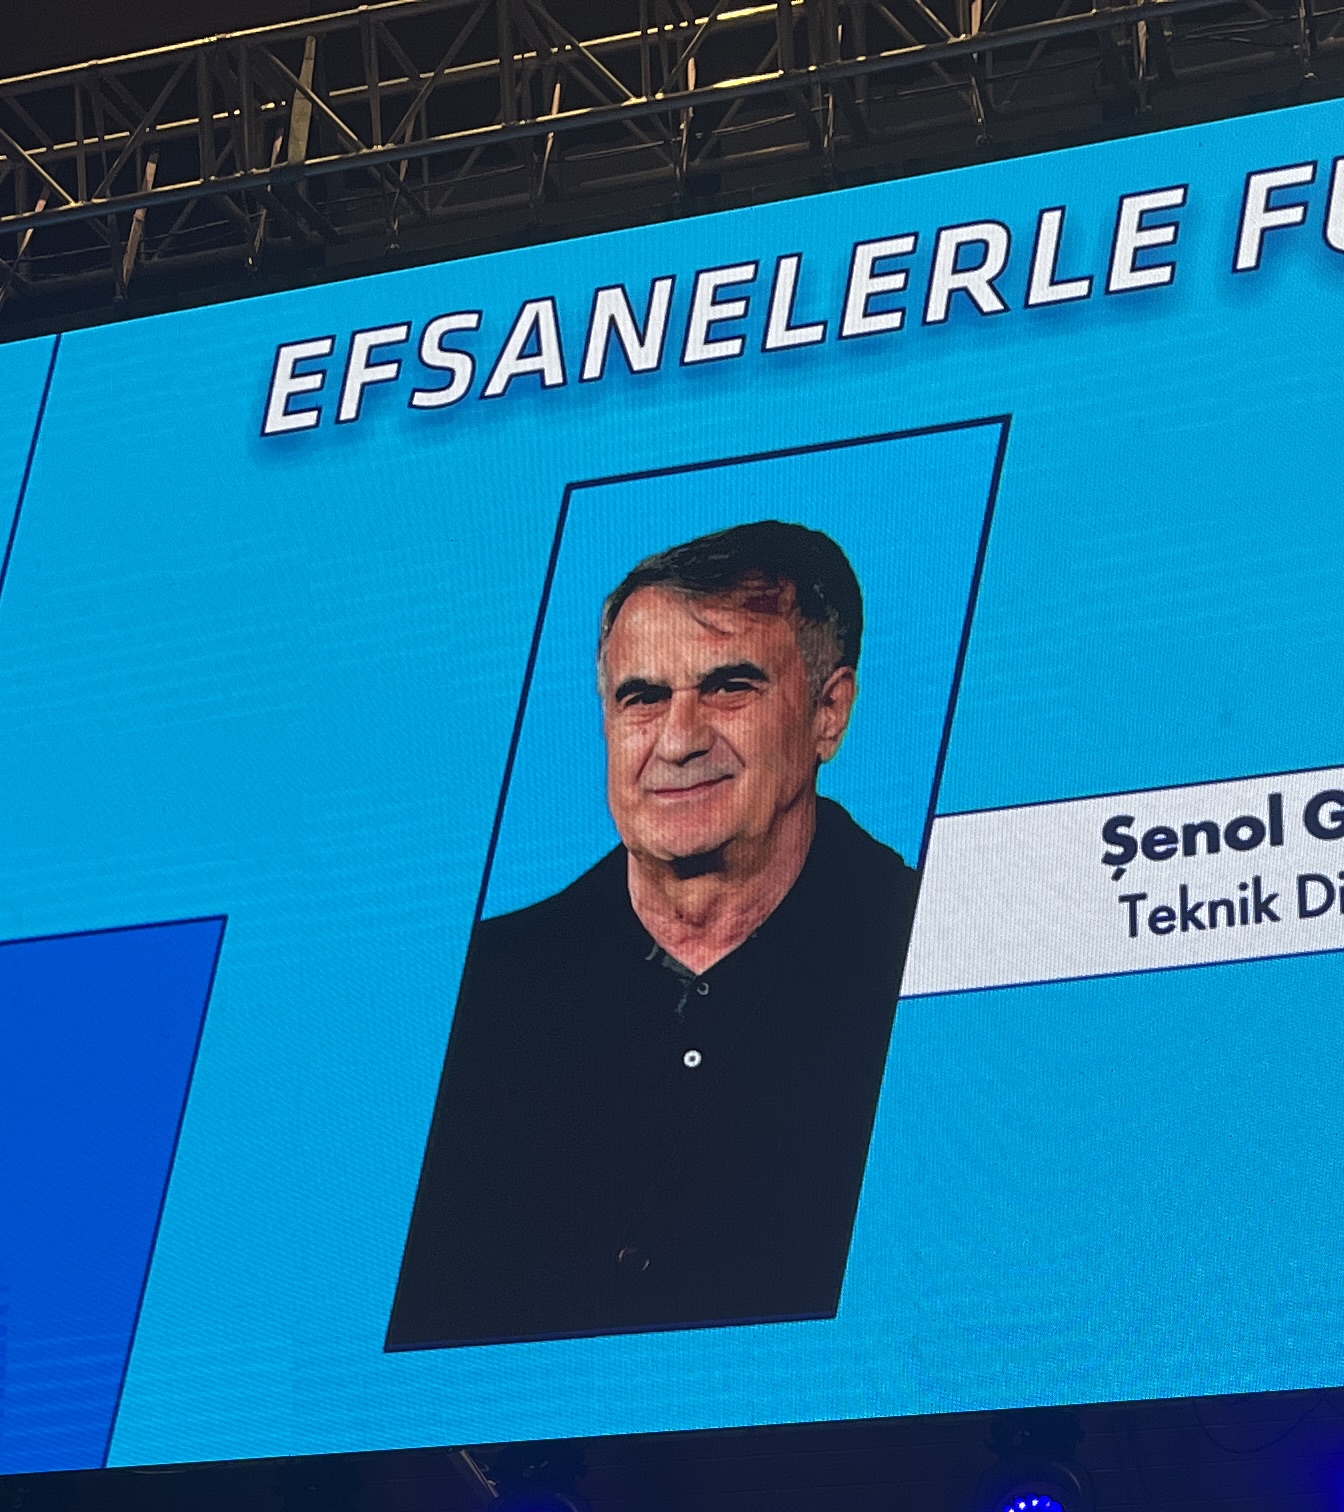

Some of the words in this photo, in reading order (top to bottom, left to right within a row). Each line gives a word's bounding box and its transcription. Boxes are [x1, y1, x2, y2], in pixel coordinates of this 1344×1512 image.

[260, 186, 1187, 437] EFSANELERLE
[1101, 792, 1284, 882] Şenol
[1118, 874, 1281, 939] Teknik
